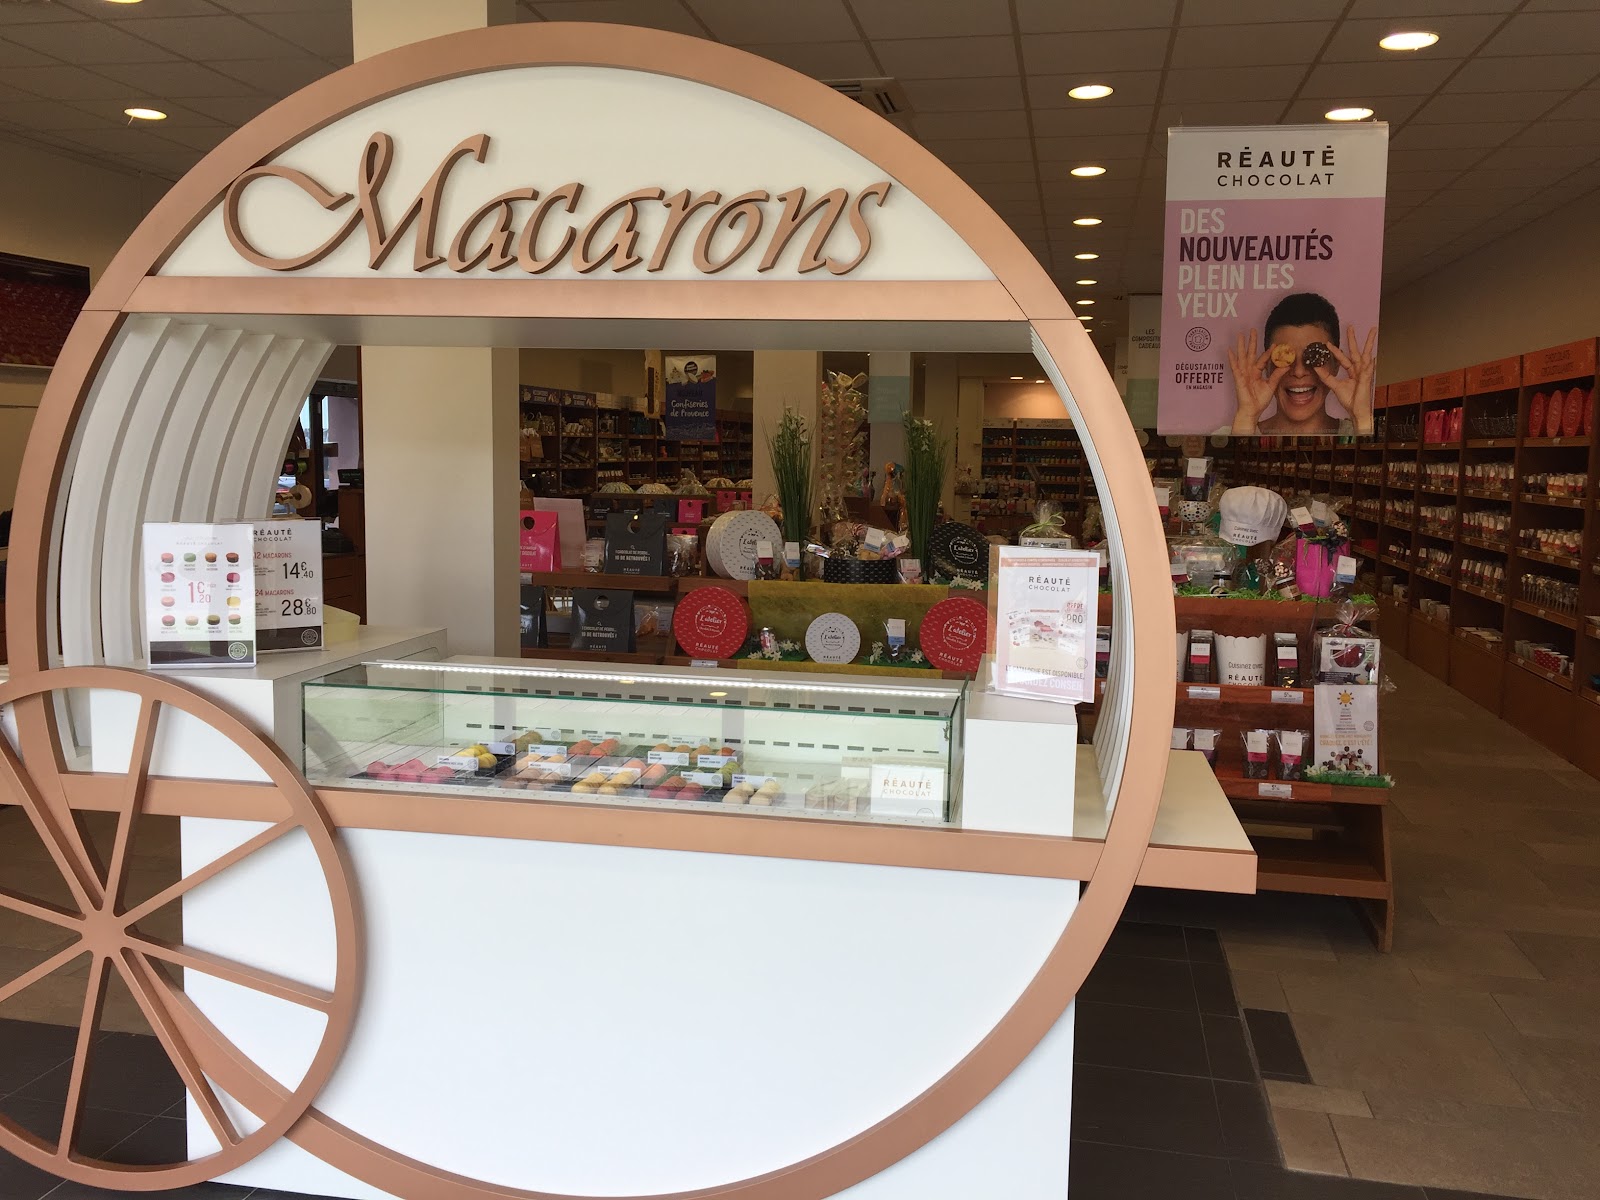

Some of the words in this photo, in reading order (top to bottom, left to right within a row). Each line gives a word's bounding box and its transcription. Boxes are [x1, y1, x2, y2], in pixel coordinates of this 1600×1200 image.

[1217, 146, 1336, 168] RÉAUTÉ
[1217, 173, 1335, 187] CHOCOLAT
[222, 131, 892, 276] Macarons
[1180, 208, 1225, 234] DES
[1179, 229, 1333, 262] NOUVEAUTÉS
[1177, 264, 1245, 290] PLEIN
[1253, 263, 1295, 290] LES
[1177, 292, 1238, 318] YEUX
[1175, 362, 1224, 371] DÉGUSTATION
[1175, 372, 1224, 384] OFFERTE
[671, 399, 709, 409] Confiseries
[670, 409, 679, 417] de
[681, 409, 709, 417] Provence
[253, 528, 293, 536] RÉAUTÉ
[1233, 533, 1257, 541] RÉAUTÉ
[254, 551, 261, 559] 12
[1028, 575, 1071, 586] RÉAUTÉ
[255, 588, 263, 596] 24
[1028, 584, 1070, 592] CHOCOLAT
[1067, 613, 1083, 624] PRO
[695, 642, 719, 650] RÉAUTÉ
[938, 652, 964, 664] RÉAUTÉ
[1228, 661, 1251, 669] Cuisinez
[1228, 673, 1263, 682] RÉAUTÉ
[883, 777, 931, 789] RÉAUTÉ
[884, 789, 931, 797] CHOCOLAT
